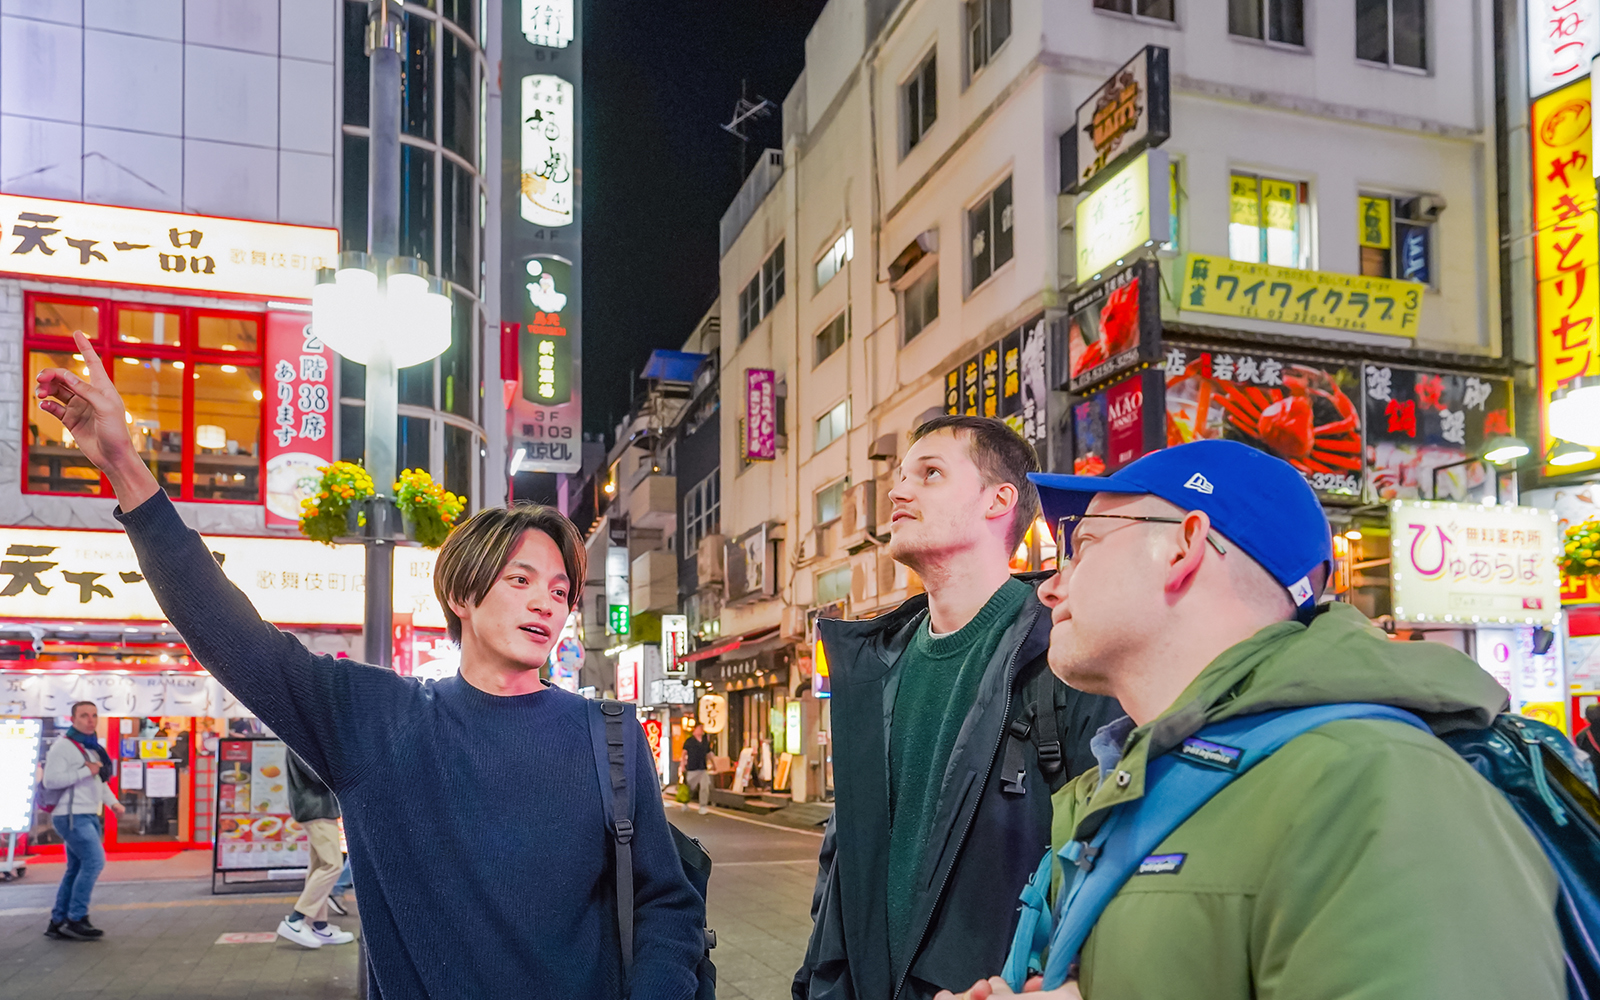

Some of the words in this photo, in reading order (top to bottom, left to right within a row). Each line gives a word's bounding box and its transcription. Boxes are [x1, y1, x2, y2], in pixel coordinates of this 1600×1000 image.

[10, 211, 216, 275] 天下一品
[229, 247, 328, 271] 歌舞伎町店
[1216, 274, 1396, 321] ワイワイクラブ
[1239, 306, 1259, 317] TEL
[1402, 290, 1418, 329] 3F
[300, 324, 328, 441] 2階38席
[275, 360, 297, 447] あります
[535, 411, 560, 422] 3F
[1466, 527, 1541, 546] 無料案内所
[256, 569, 365, 592] 歌舞伎町店
[87, 678, 136, 688] KYOTO
[147, 678, 197, 688] RAMEN
[1183, 745, 1231, 764] patagonia
